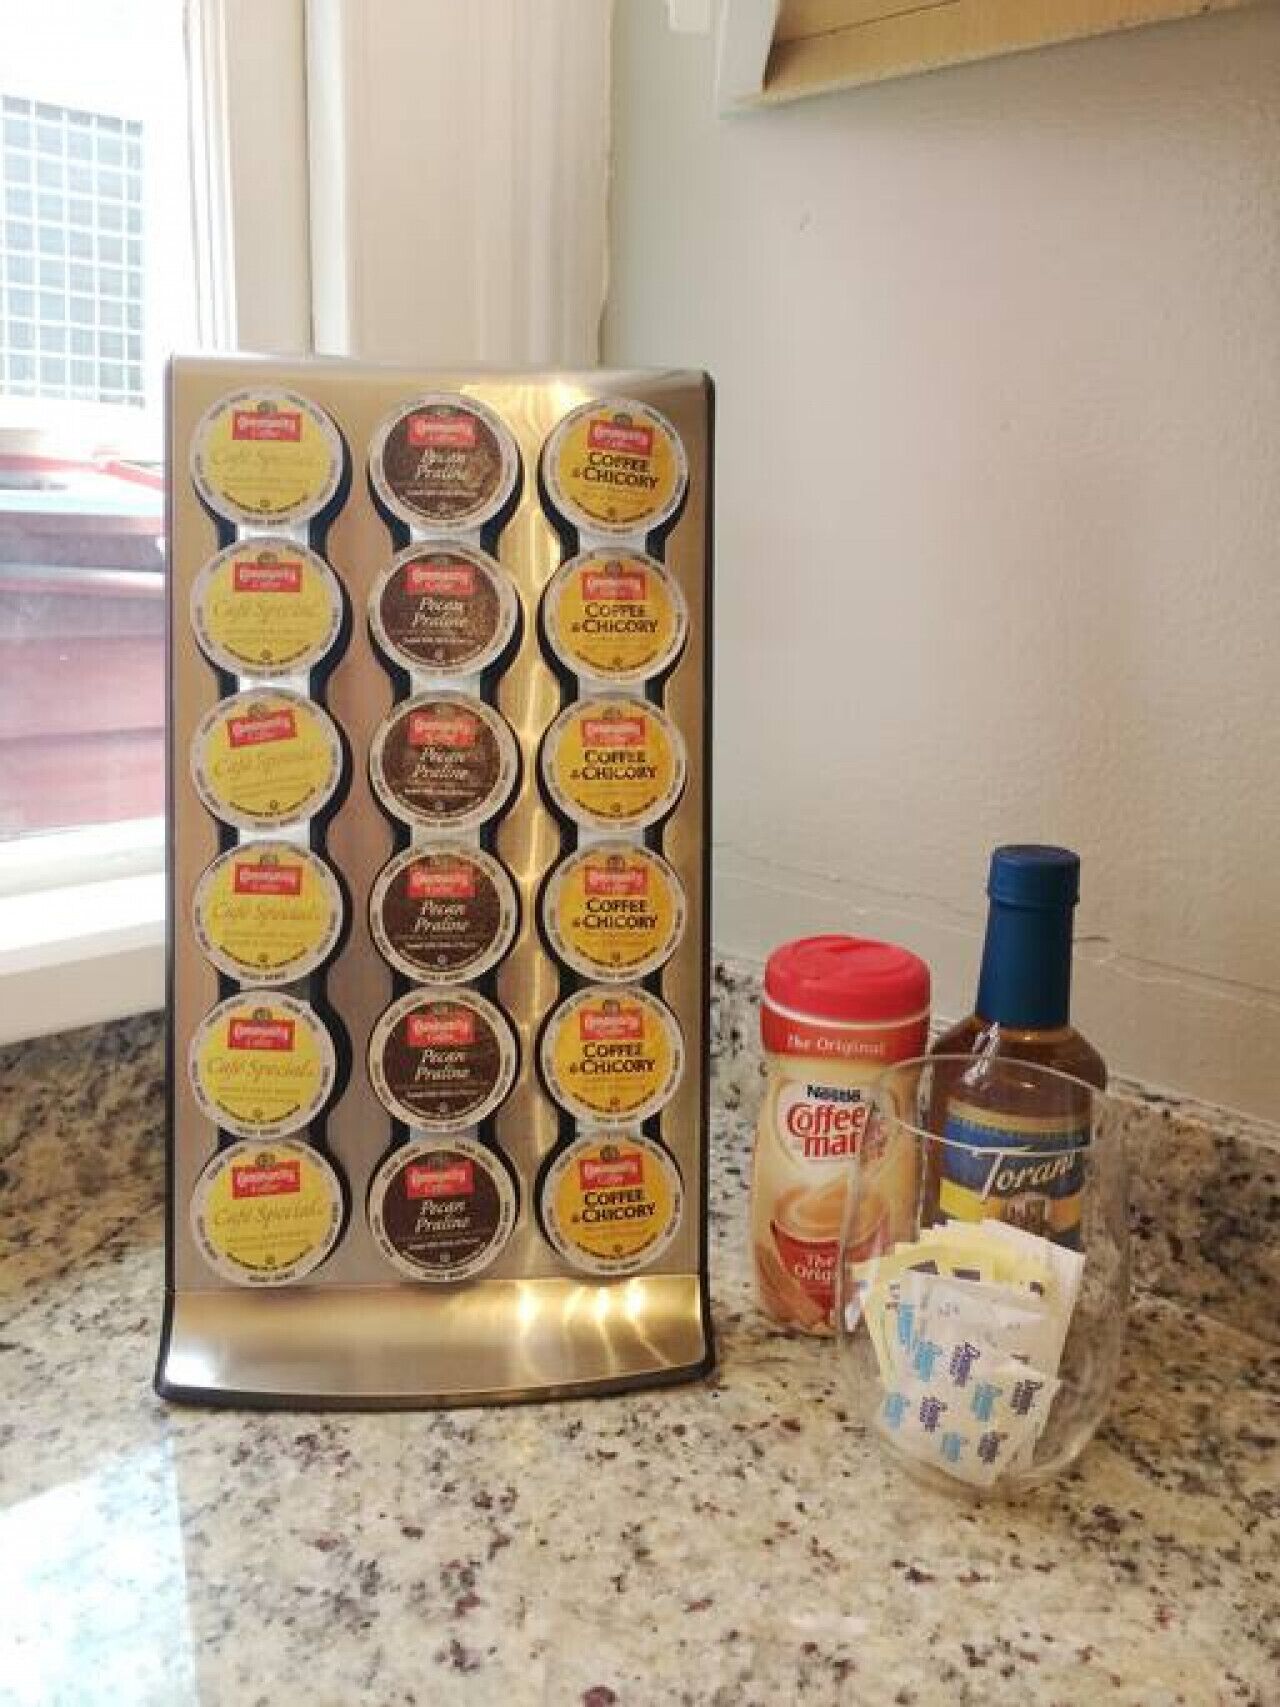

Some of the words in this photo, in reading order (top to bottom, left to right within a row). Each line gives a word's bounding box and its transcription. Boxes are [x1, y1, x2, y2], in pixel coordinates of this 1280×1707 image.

[588, 452, 650, 474] COFFEE
[582, 466, 660, 489] CHICORY
[584, 603, 648, 618] COFFEE
[582, 619, 659, 634] CHICORY
[584, 749, 646, 763] COFFEE
[581, 766, 658, 780] CHICORY
[585, 899, 648, 914] COFFEE
[582, 915, 658, 930] CHICORY
[582, 1041, 644, 1059] COFFEE
[816, 1037, 887, 1056] Original
[421, 1050, 466, 1063] Pecan
[415, 1063, 471, 1081] Praline
[579, 1058, 656, 1076] CHICORY
[787, 1102, 867, 1138] Coffee
[584, 1190, 646, 1207] COFFEE
[581, 1202, 656, 1224] CHICORY
